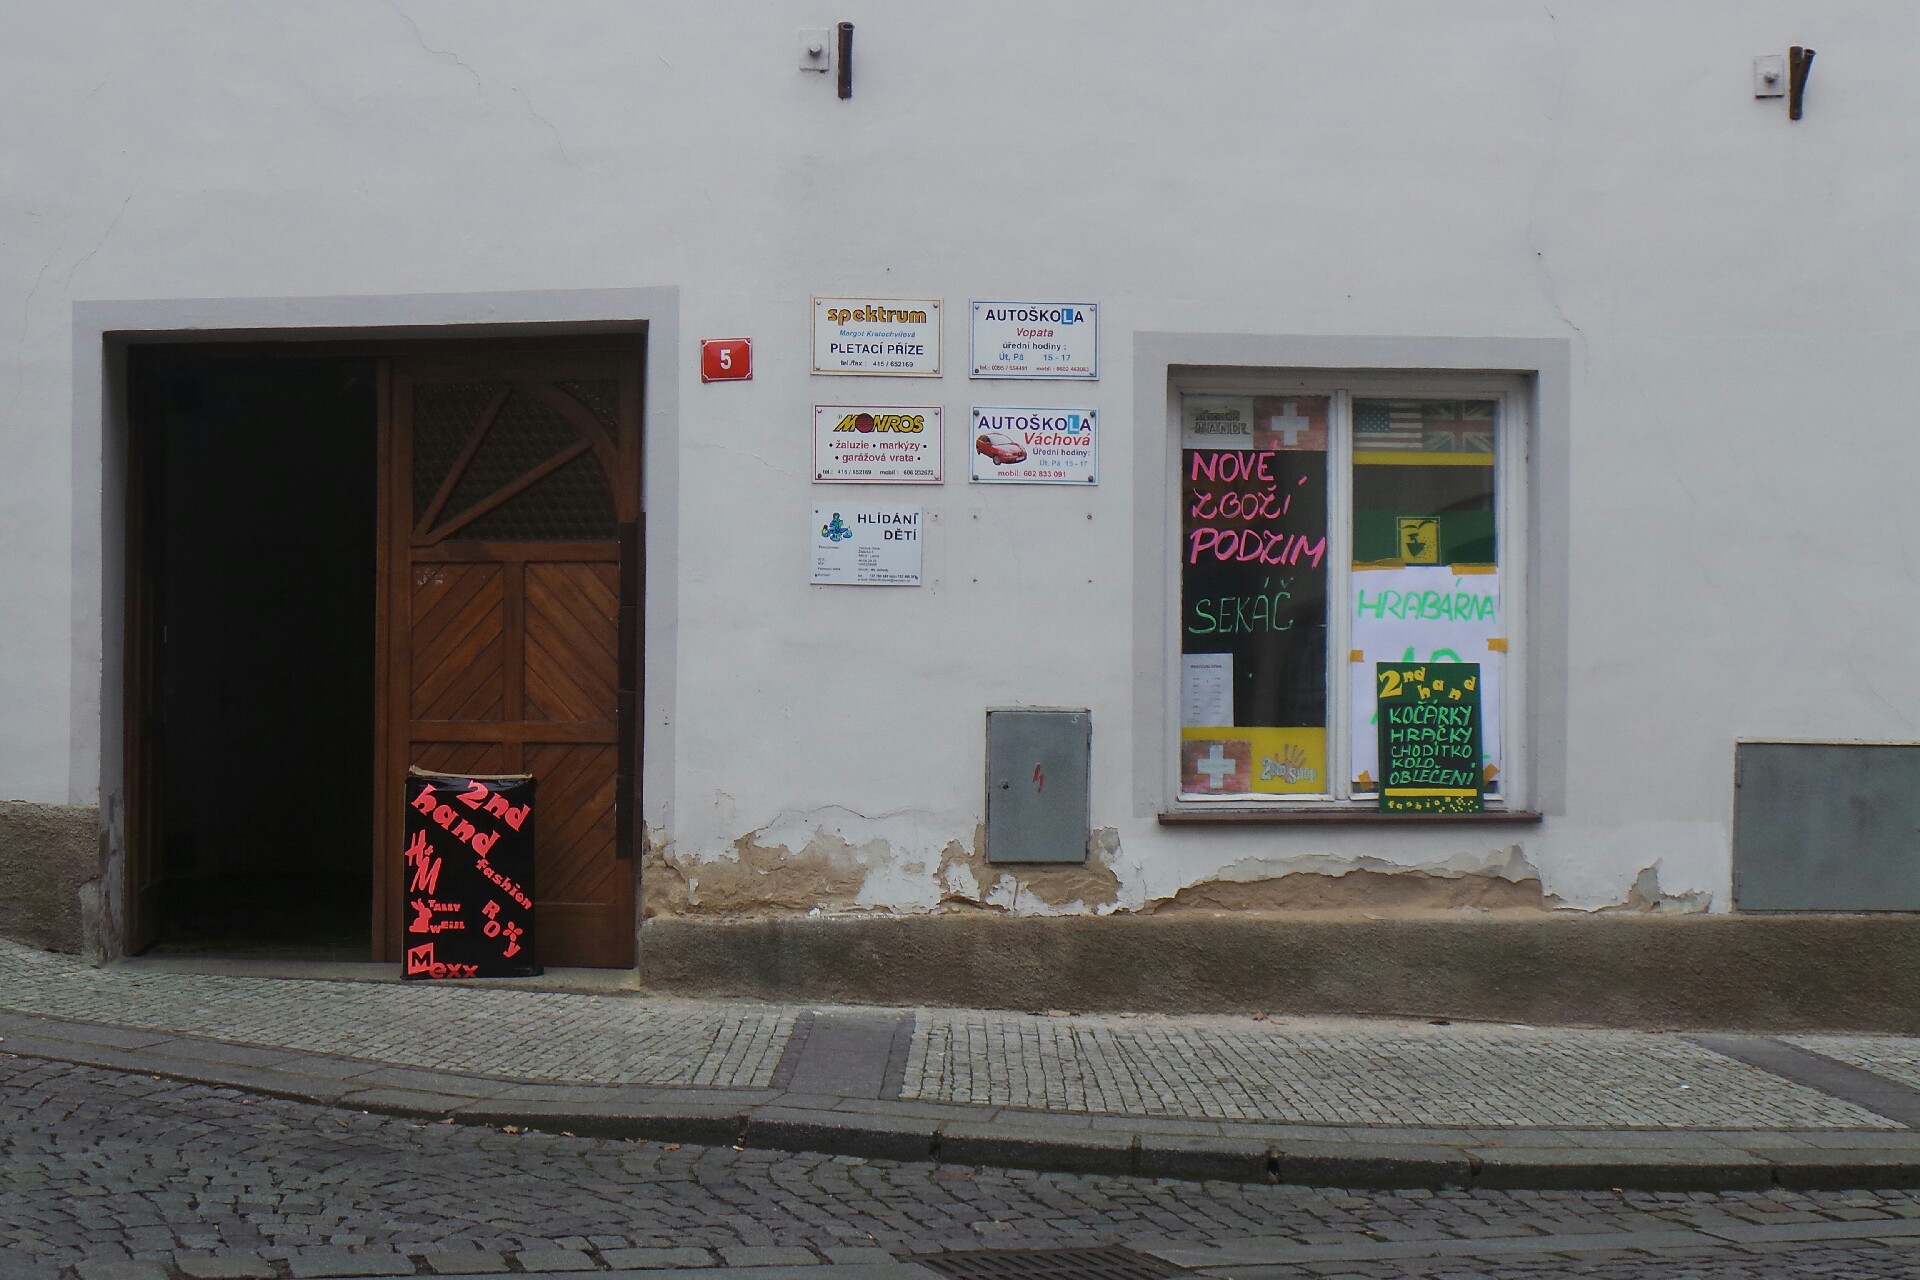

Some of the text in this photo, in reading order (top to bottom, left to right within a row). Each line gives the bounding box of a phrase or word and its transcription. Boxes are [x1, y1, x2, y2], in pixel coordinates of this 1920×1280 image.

[827, 305, 927, 326] spektrum
[985, 306, 1084, 324] AUTOŠKOLA
[839, 329, 865, 339] Margot
[1016, 327, 1054, 339] Vopata
[830, 342, 924, 355] PLETACÍ PŘÍZE
[1002, 341, 1030, 350] úřední
[1032, 343, 1061, 351] hodiny
[720, 349, 732, 370] 5
[833, 413, 925, 434] MONROS
[978, 414, 1092, 434] AUTOŠKOLA
[836, 440, 920, 451] žaluzie markýzy
[1024, 432, 1091, 446] Váchová
[842, 454, 886, 463] garážová
[1061, 448, 1090, 458] hodiny:
[1191, 440, 1279, 482] NOVÉ
[857, 512, 918, 525] HLÍDÁNÍ
[884, 527, 917, 541] DĚTÍ
[1190, 527, 1327, 568] PODZIM
[1188, 576, 1294, 634] SEKÁČ
[1357, 577, 1497, 624] HRABÁRNA
[1379, 667, 1426, 698] 2nd
[1417, 676, 1477, 700] hand
[1389, 700, 1473, 726] KOČÁRKY
[1390, 725, 1473, 743] HRAČKY
[456, 780, 531, 832] 2nd
[411, 784, 501, 858] hand
[476, 859, 532, 910] fashion
[428, 899, 461, 912] TALLY
